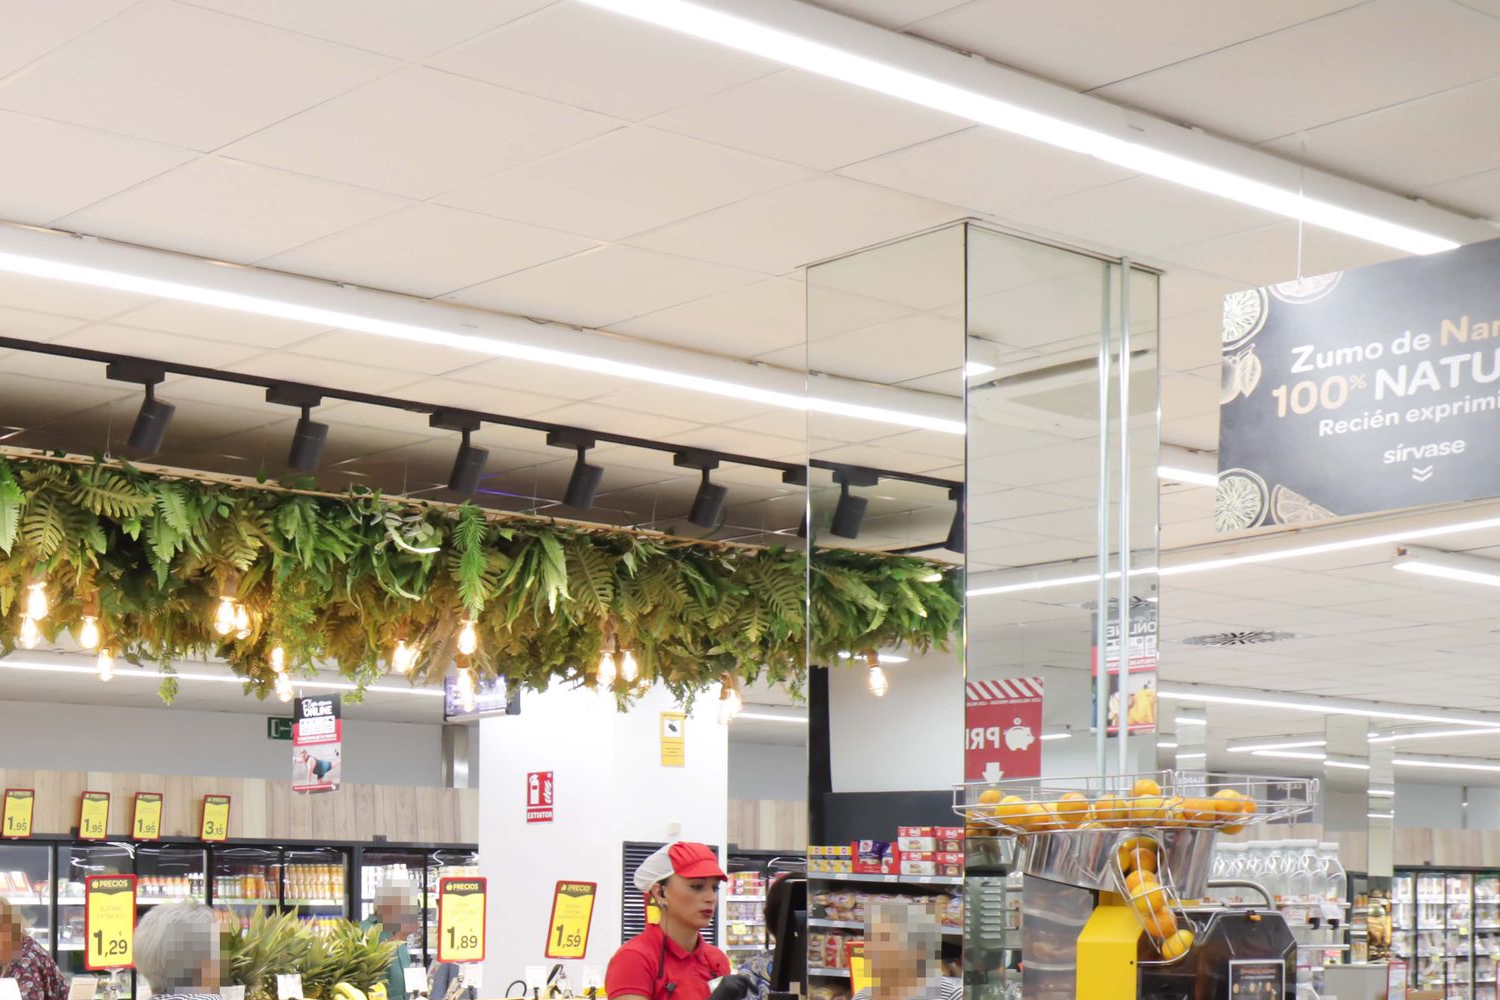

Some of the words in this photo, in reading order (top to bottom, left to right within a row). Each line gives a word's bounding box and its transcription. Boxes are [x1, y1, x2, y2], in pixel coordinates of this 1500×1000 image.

[1291, 342, 1383, 374] Zumo
[1391, 331, 1431, 354] de
[1374, 347, 1500, 401] NATU
[1319, 407, 1400, 437] Recién
[1383, 439, 1466, 465] sírvase
[99, 879, 128, 888] PRECIOS
[93, 929, 128, 958] 1,29
[446, 926, 478, 951] 1,89
[556, 923, 582, 948] 1,59
